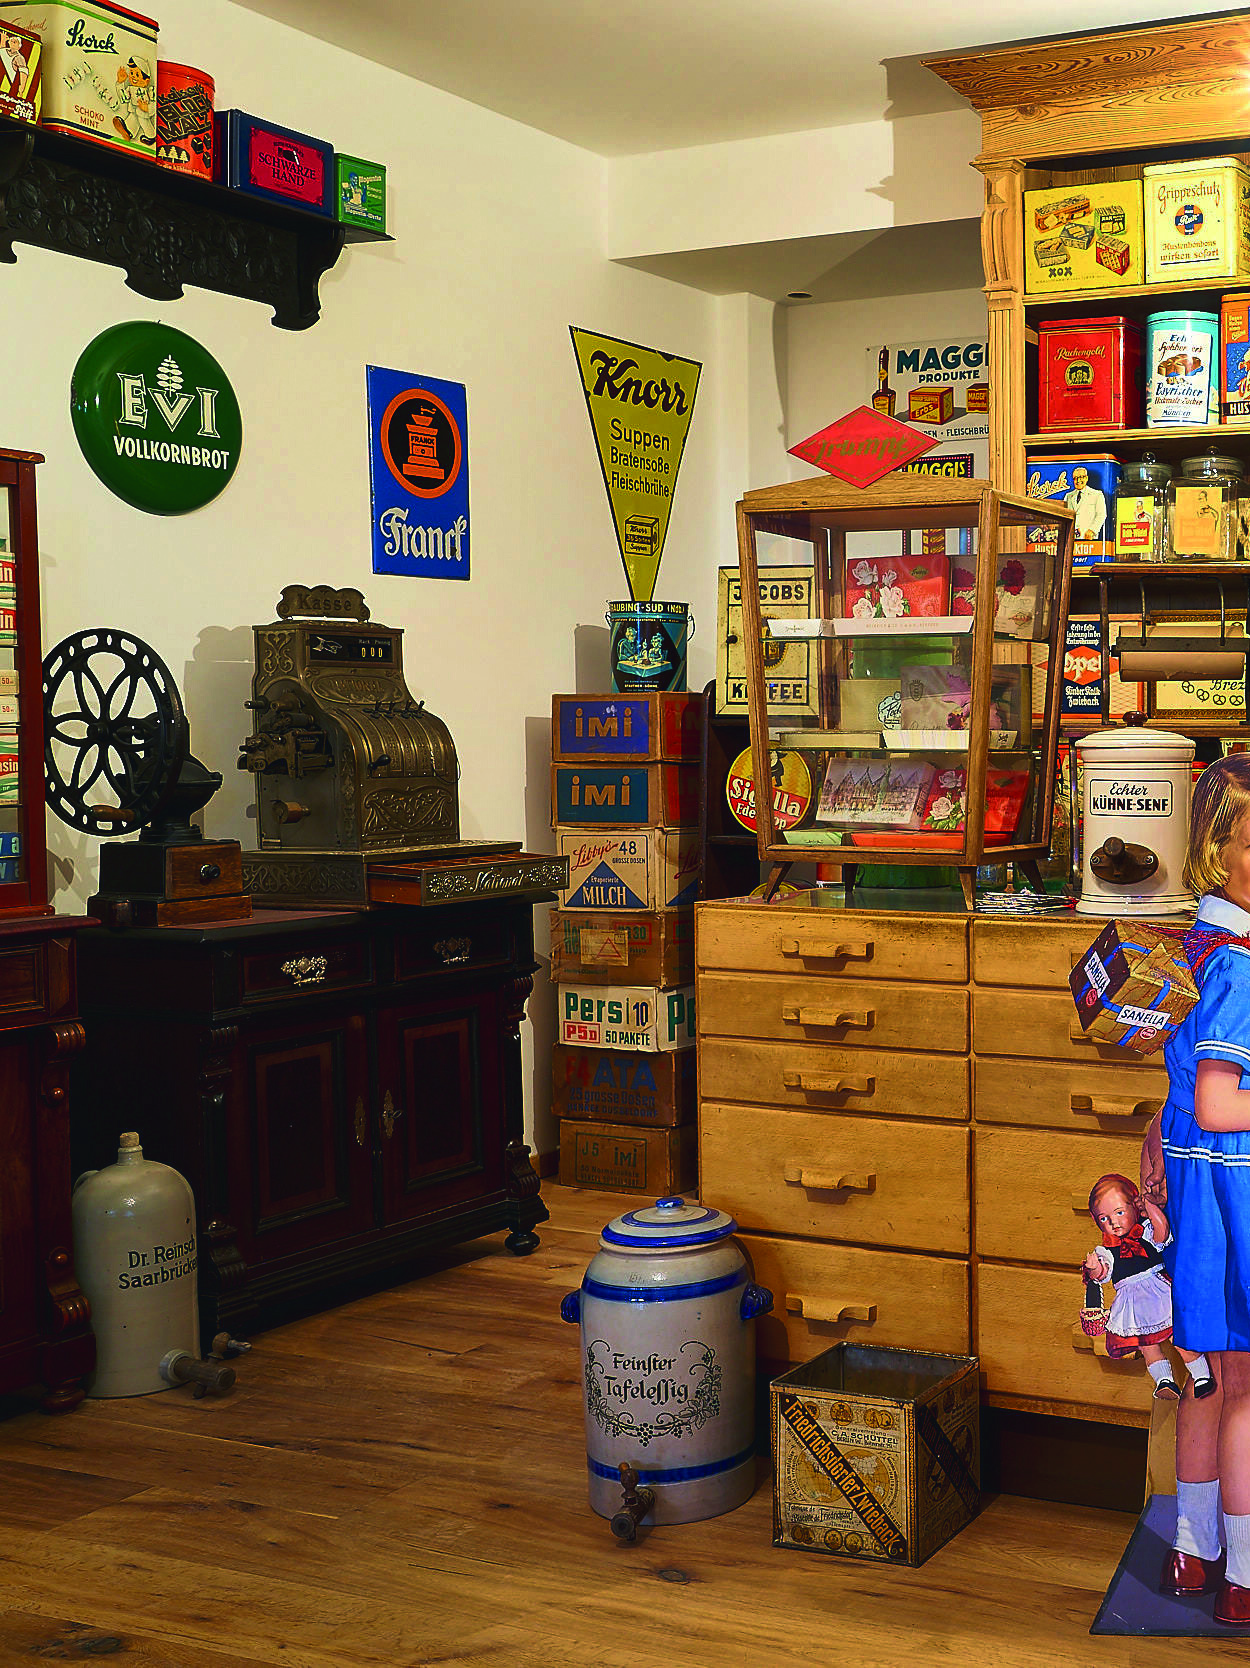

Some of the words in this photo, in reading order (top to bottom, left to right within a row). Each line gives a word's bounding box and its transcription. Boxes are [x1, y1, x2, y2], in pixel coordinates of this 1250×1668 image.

[65, 19, 119, 54] Storck
[74, 104, 105, 122] SCHOKO
[80, 115, 100, 128] MINT
[258, 152, 316, 180] SCHWARZE
[272, 167, 305, 186] HAND
[1160, 252, 1190, 261] wirken
[1194, 248, 1218, 259] sofort
[1049, 267, 1072, 278] XOX
[1054, 345, 1106, 360] Rachengold
[590, 350, 689, 416] Knorr
[918, 370, 980, 383] PRODUKTE
[116, 373, 221, 438] EVI
[610, 418, 670, 452] Suppen
[946, 425, 989, 437] FLEISCHBRÜ
[411, 435, 435, 447] FRANCK
[113, 435, 230, 470] VOLLKORNBROT
[610, 446, 670, 475] Bratensoße
[611, 471, 670, 498] Fleischbrühe
[1027, 471, 1070, 499] Storck
[380, 507, 467, 562] Franck
[733, 584, 804, 601] JCOBS
[297, 593, 351, 611] Kasse
[732, 684, 803, 700] KFEE
[1109, 782, 1149, 796] Echter
[1092, 795, 1169, 812] KÜHNE-SENF
[571, 840, 619, 871] Libby's
[619, 840, 637, 855] 48
[582, 886, 627, 906] MILCH
[1088, 957, 1107, 994] SANELLA
[632, 1002, 649, 1026] 10
[1121, 1009, 1165, 1027] SANELLA
[619, 1031, 650, 1046] PAKETE
[592, 1057, 658, 1092] ATA
[621, 1091, 655, 1106] Dosen
[128, 1251, 150, 1268] Dr.
[849, 1486, 900, 1556] Zwieback
